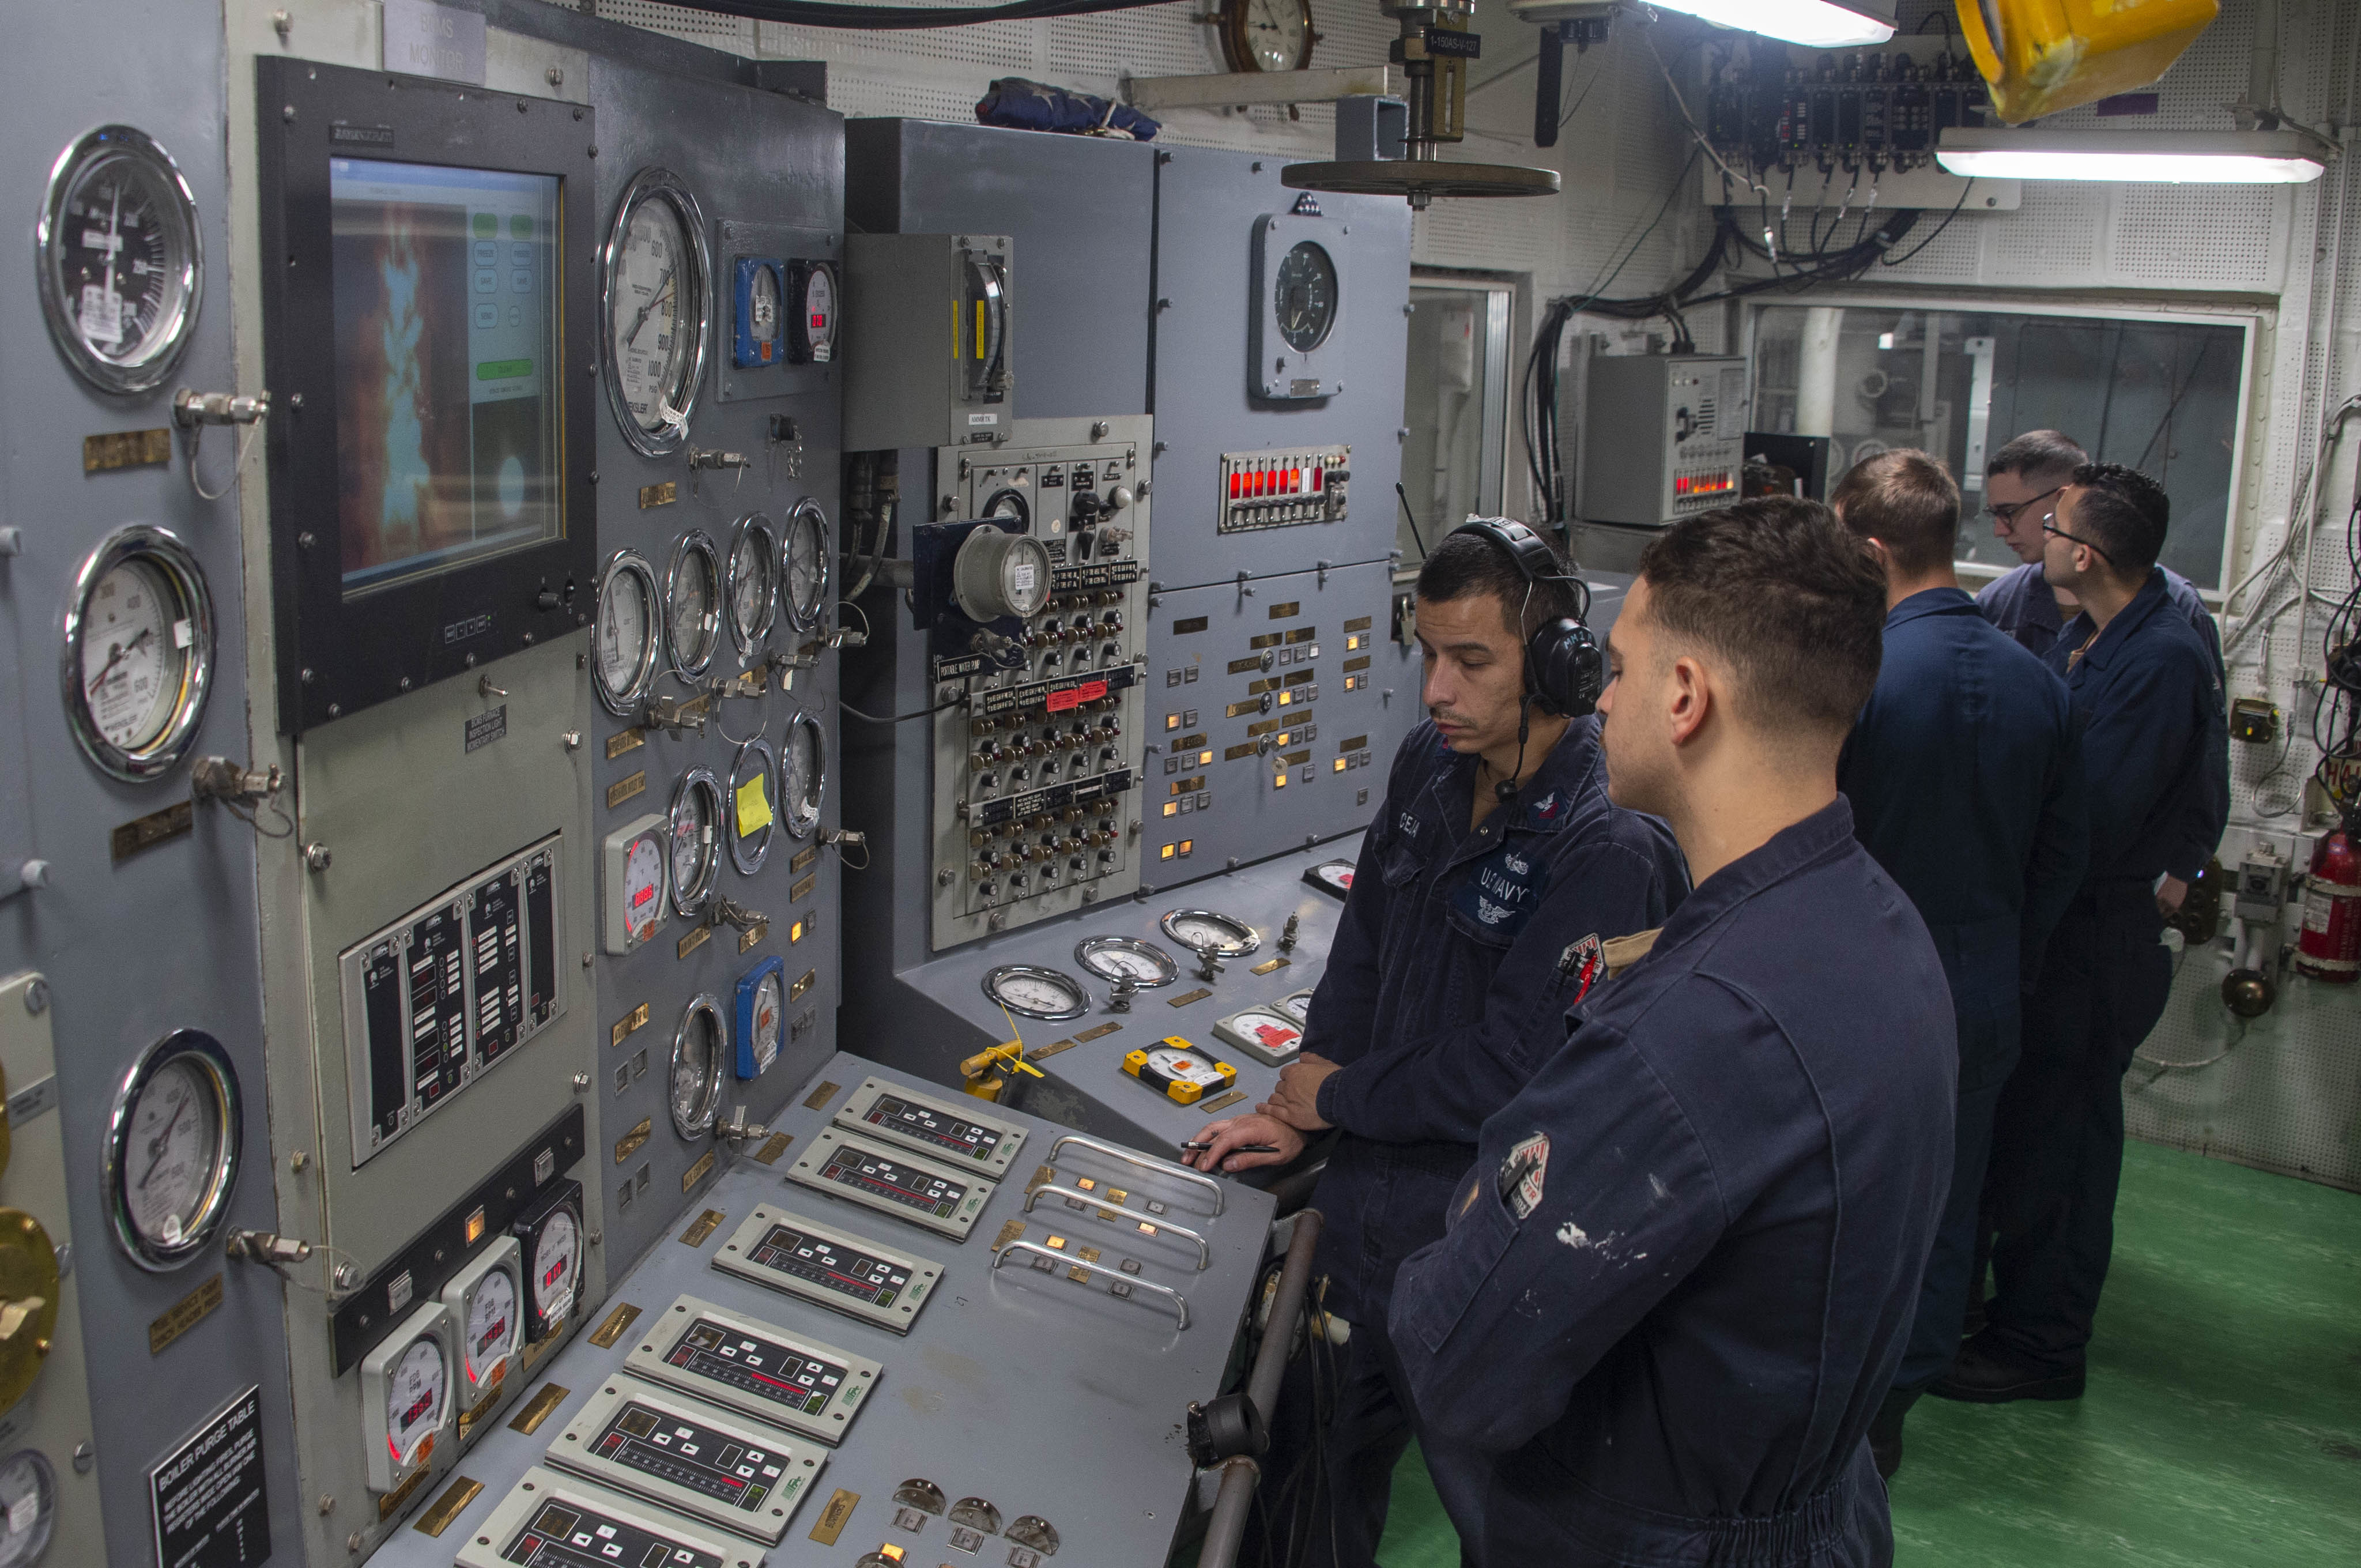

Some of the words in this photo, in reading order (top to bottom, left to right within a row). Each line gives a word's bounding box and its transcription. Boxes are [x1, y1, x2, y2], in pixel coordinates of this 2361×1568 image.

[409, 40, 464, 70] MONITOR
[651, 239, 662, 259] 600
[659, 267, 670, 287] 700
[661, 300, 673, 318] 800
[658, 333, 669, 351] 900
[648, 360, 661, 378] 1000
[940, 664, 959, 677] PORTABLE
[959, 661, 971, 673] WATER
[971, 659, 980, 670] PUMP
[491, 717, 503, 729] LIGHT
[1400, 812, 1420, 838] CEJA
[1491, 876, 1530, 903] NAVY
[409, 1378, 421, 1393] RPM
[159, 1452, 195, 1493] BOILER
[193, 1423, 228, 1461] PURGE
[227, 1400, 255, 1432] TABLE
[164, 1485, 190, 1513] BEFORE
[233, 1428, 255, 1450] PURGE
[176, 1488, 198, 1515] BOILER
[825, 1503, 846, 1529] BURNERS
